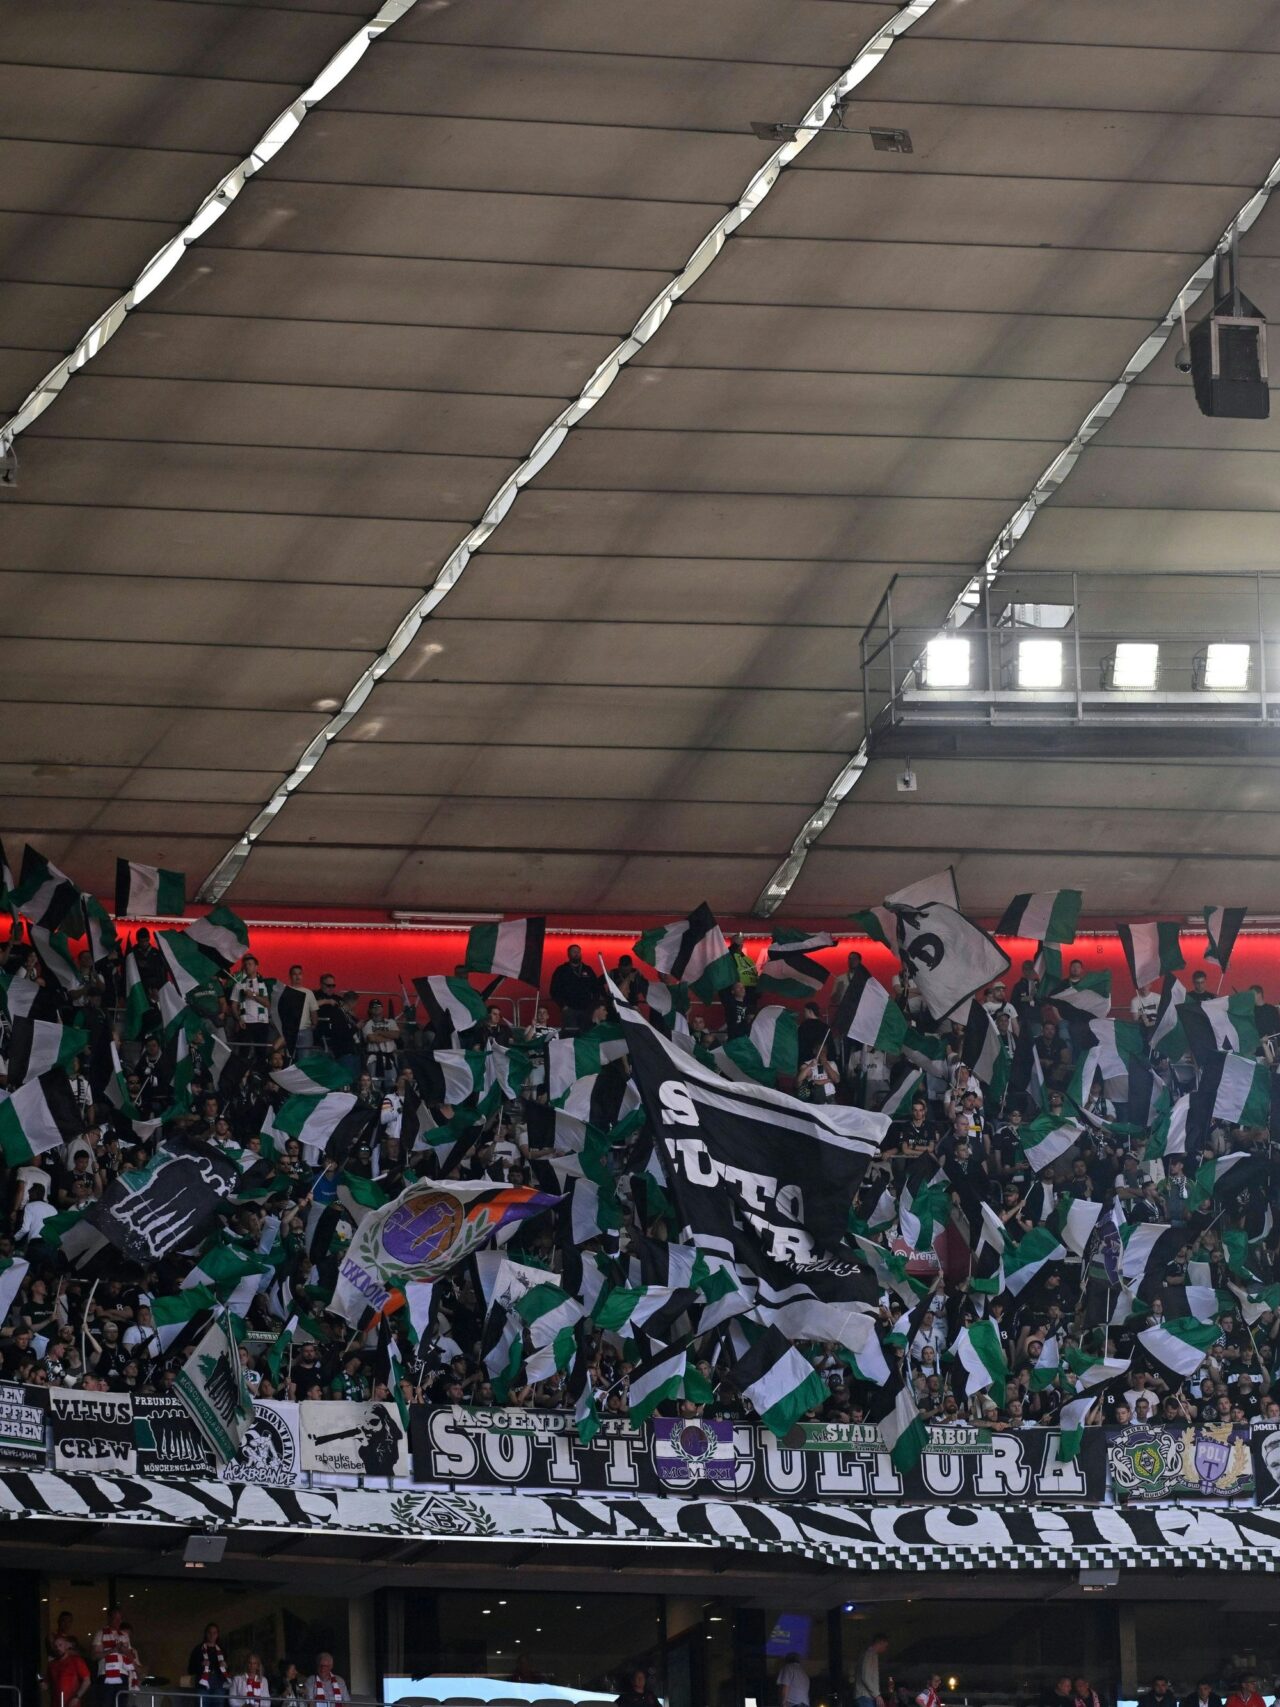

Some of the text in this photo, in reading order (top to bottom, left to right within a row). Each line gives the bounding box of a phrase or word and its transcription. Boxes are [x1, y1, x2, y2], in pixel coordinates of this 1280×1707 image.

[909, 1251, 937, 1261] Arena
[0, 1387, 25, 1404] EN
[0, 1403, 42, 1424] PFEN
[52, 1398, 133, 1425] VITUS
[1253, 1423, 1278, 1431] IMMER
[58, 1437, 133, 1461] CREW
[315, 1453, 349, 1463] rabauke
[223, 1461, 298, 1486] ACKERBANDE
